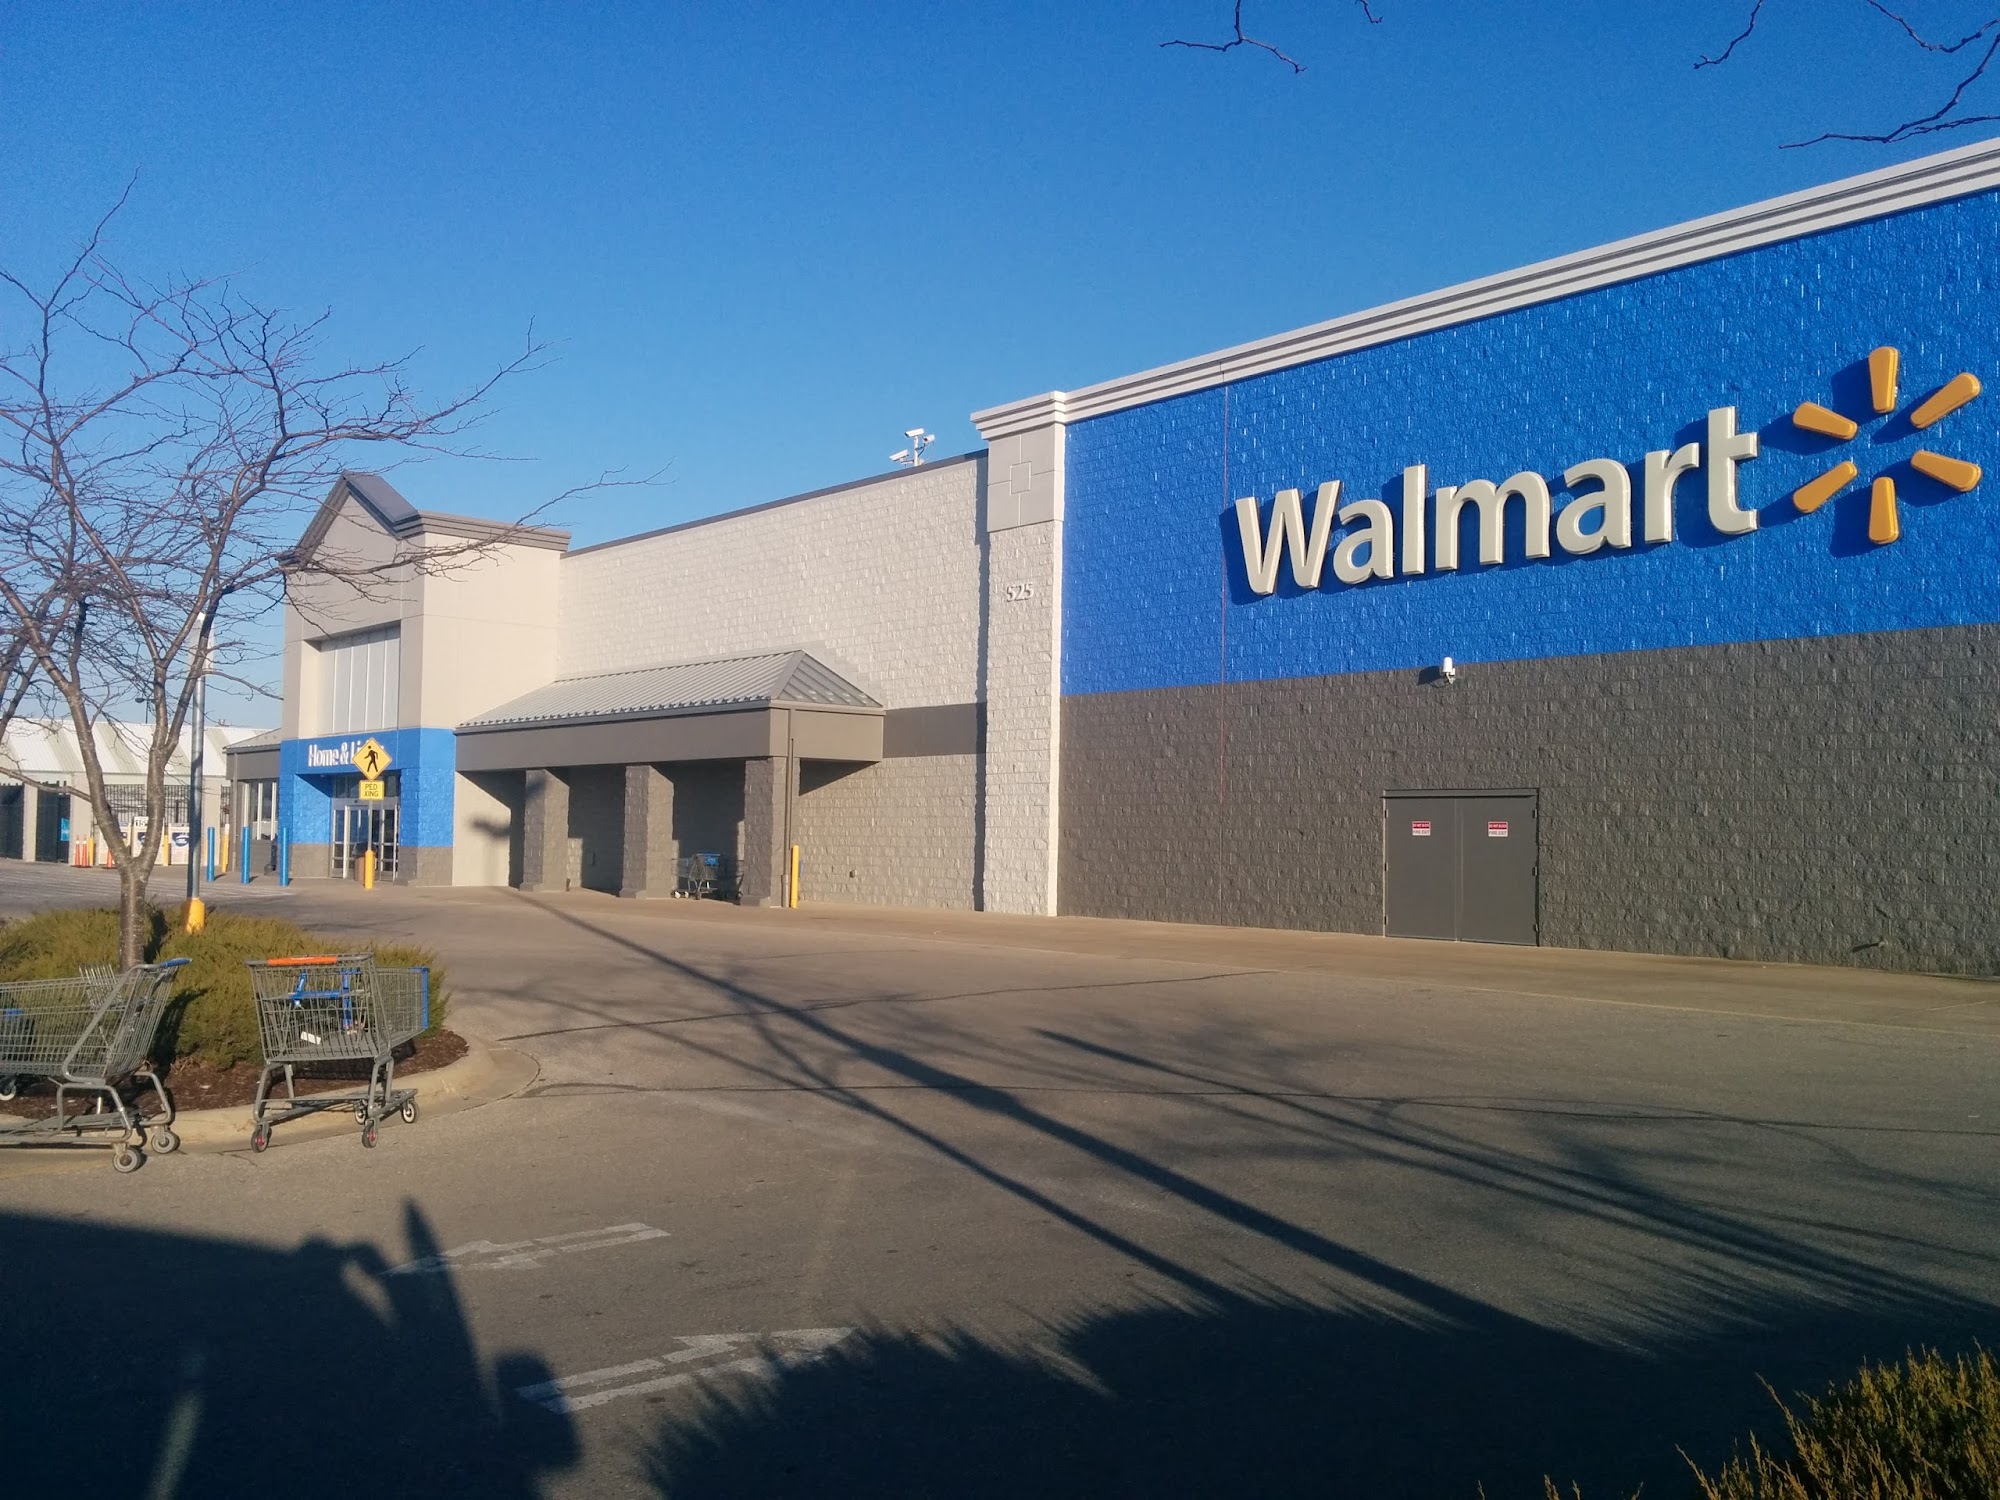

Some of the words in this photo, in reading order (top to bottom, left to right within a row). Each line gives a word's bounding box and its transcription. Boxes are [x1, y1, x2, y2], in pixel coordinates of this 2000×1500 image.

[1235, 405, 1759, 595] Walmart
[1006, 582, 1034, 602] 525
[308, 744, 339, 767] Home
[340, 742, 349, 765] &
[364, 783, 378, 791] PED
